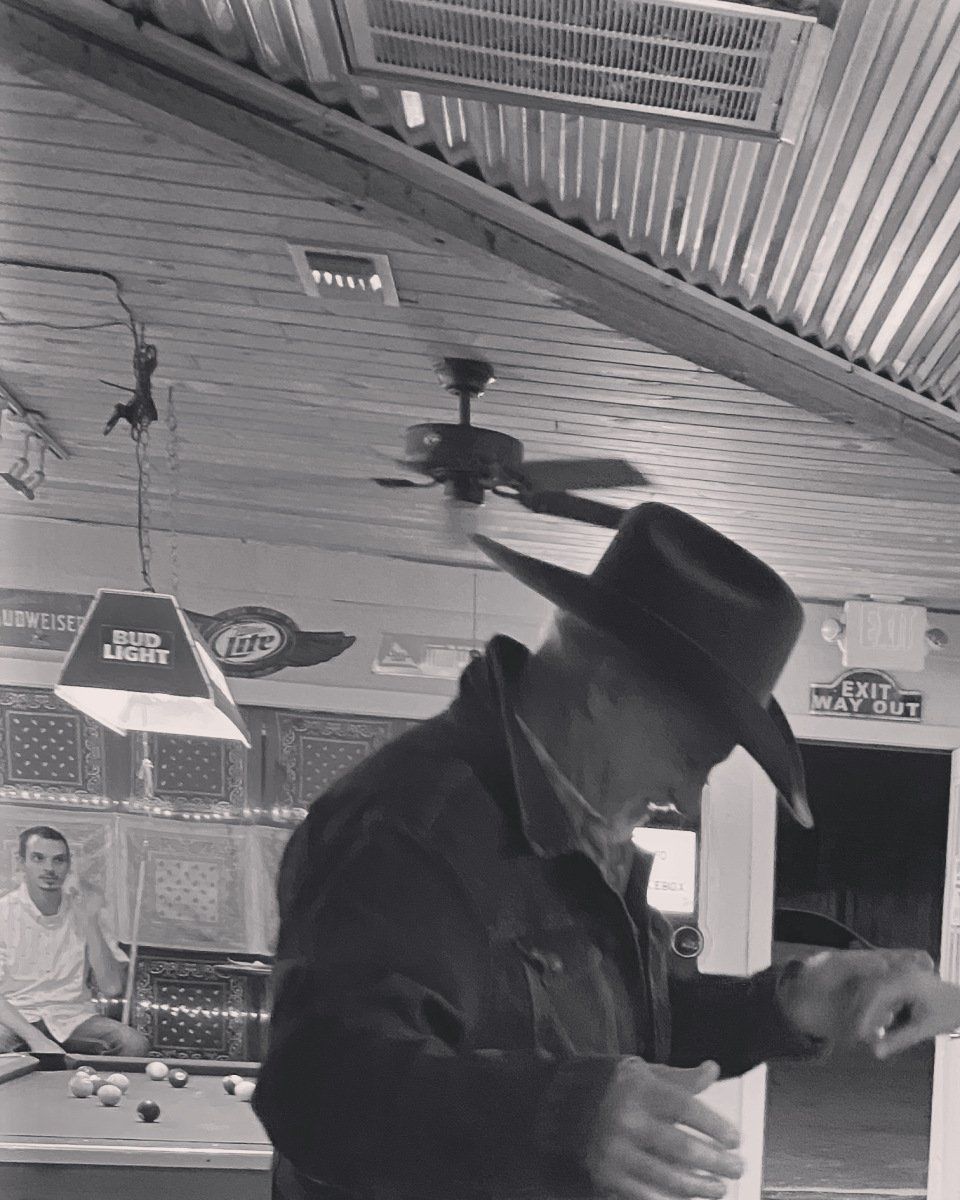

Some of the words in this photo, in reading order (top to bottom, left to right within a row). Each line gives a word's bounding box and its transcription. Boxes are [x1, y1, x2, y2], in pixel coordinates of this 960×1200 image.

[0, 608, 87, 632] UDWEISER
[112, 629, 162, 648] BUD
[224, 633, 276, 659] Lite
[103, 643, 171, 665] LIGHT
[841, 680, 892, 700] EXIT
[812, 694, 864, 712] WAY
[872, 699, 920, 717] OUT
